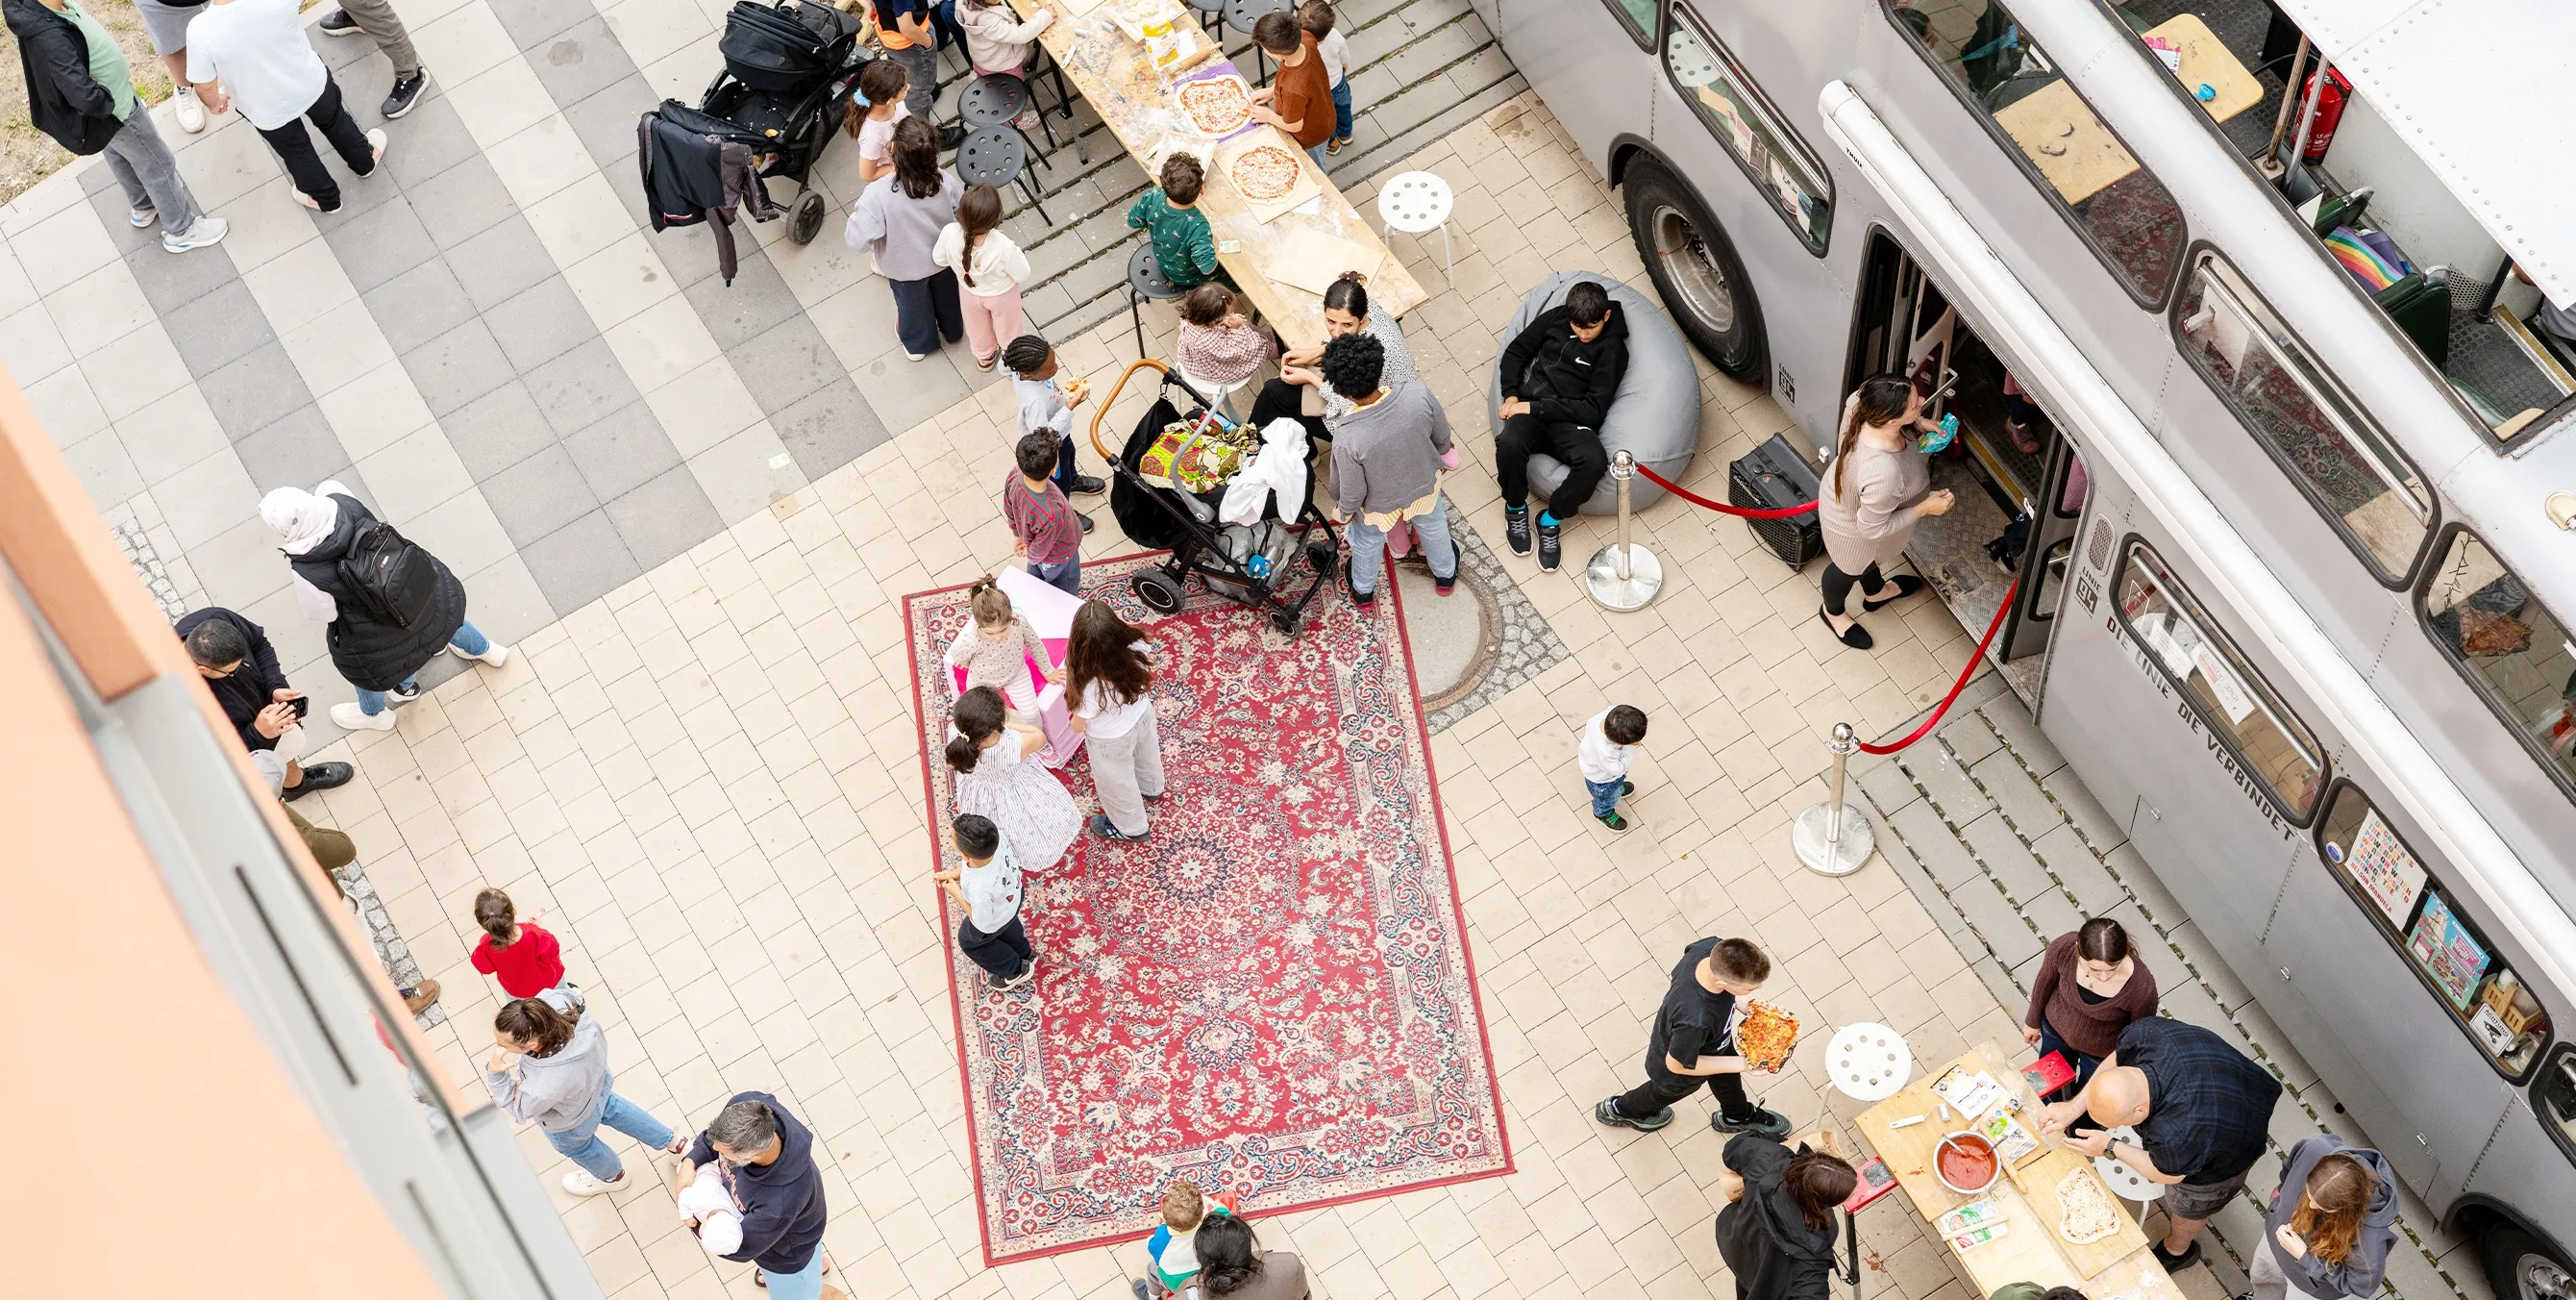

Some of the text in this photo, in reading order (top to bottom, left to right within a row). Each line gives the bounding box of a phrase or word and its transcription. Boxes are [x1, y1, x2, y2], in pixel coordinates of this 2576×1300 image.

[1779, 371, 1795, 403] 94
[2077, 577, 2097, 614] 94
[2082, 565, 2102, 593] LINIE
[2106, 615, 2131, 651] DIE
[2135, 650, 2171, 699] LINIE
[2178, 702, 2202, 735] DIE
[2207, 733, 2295, 841] VERBINDET
[2368, 823, 2382, 839] THE
[2356, 848, 2382, 881] CHANGE
[2362, 836, 2390, 868] WEAPON
[2365, 829, 2398, 869] POWERFUL
[2360, 842, 2372, 860] YOU
[2373, 858, 2388, 876] CAN
[2388, 875, 2399, 892] USE
[2351, 862, 2392, 913] NELSON MANDELA
[2485, 1009, 2510, 1038] ACHTUNG
